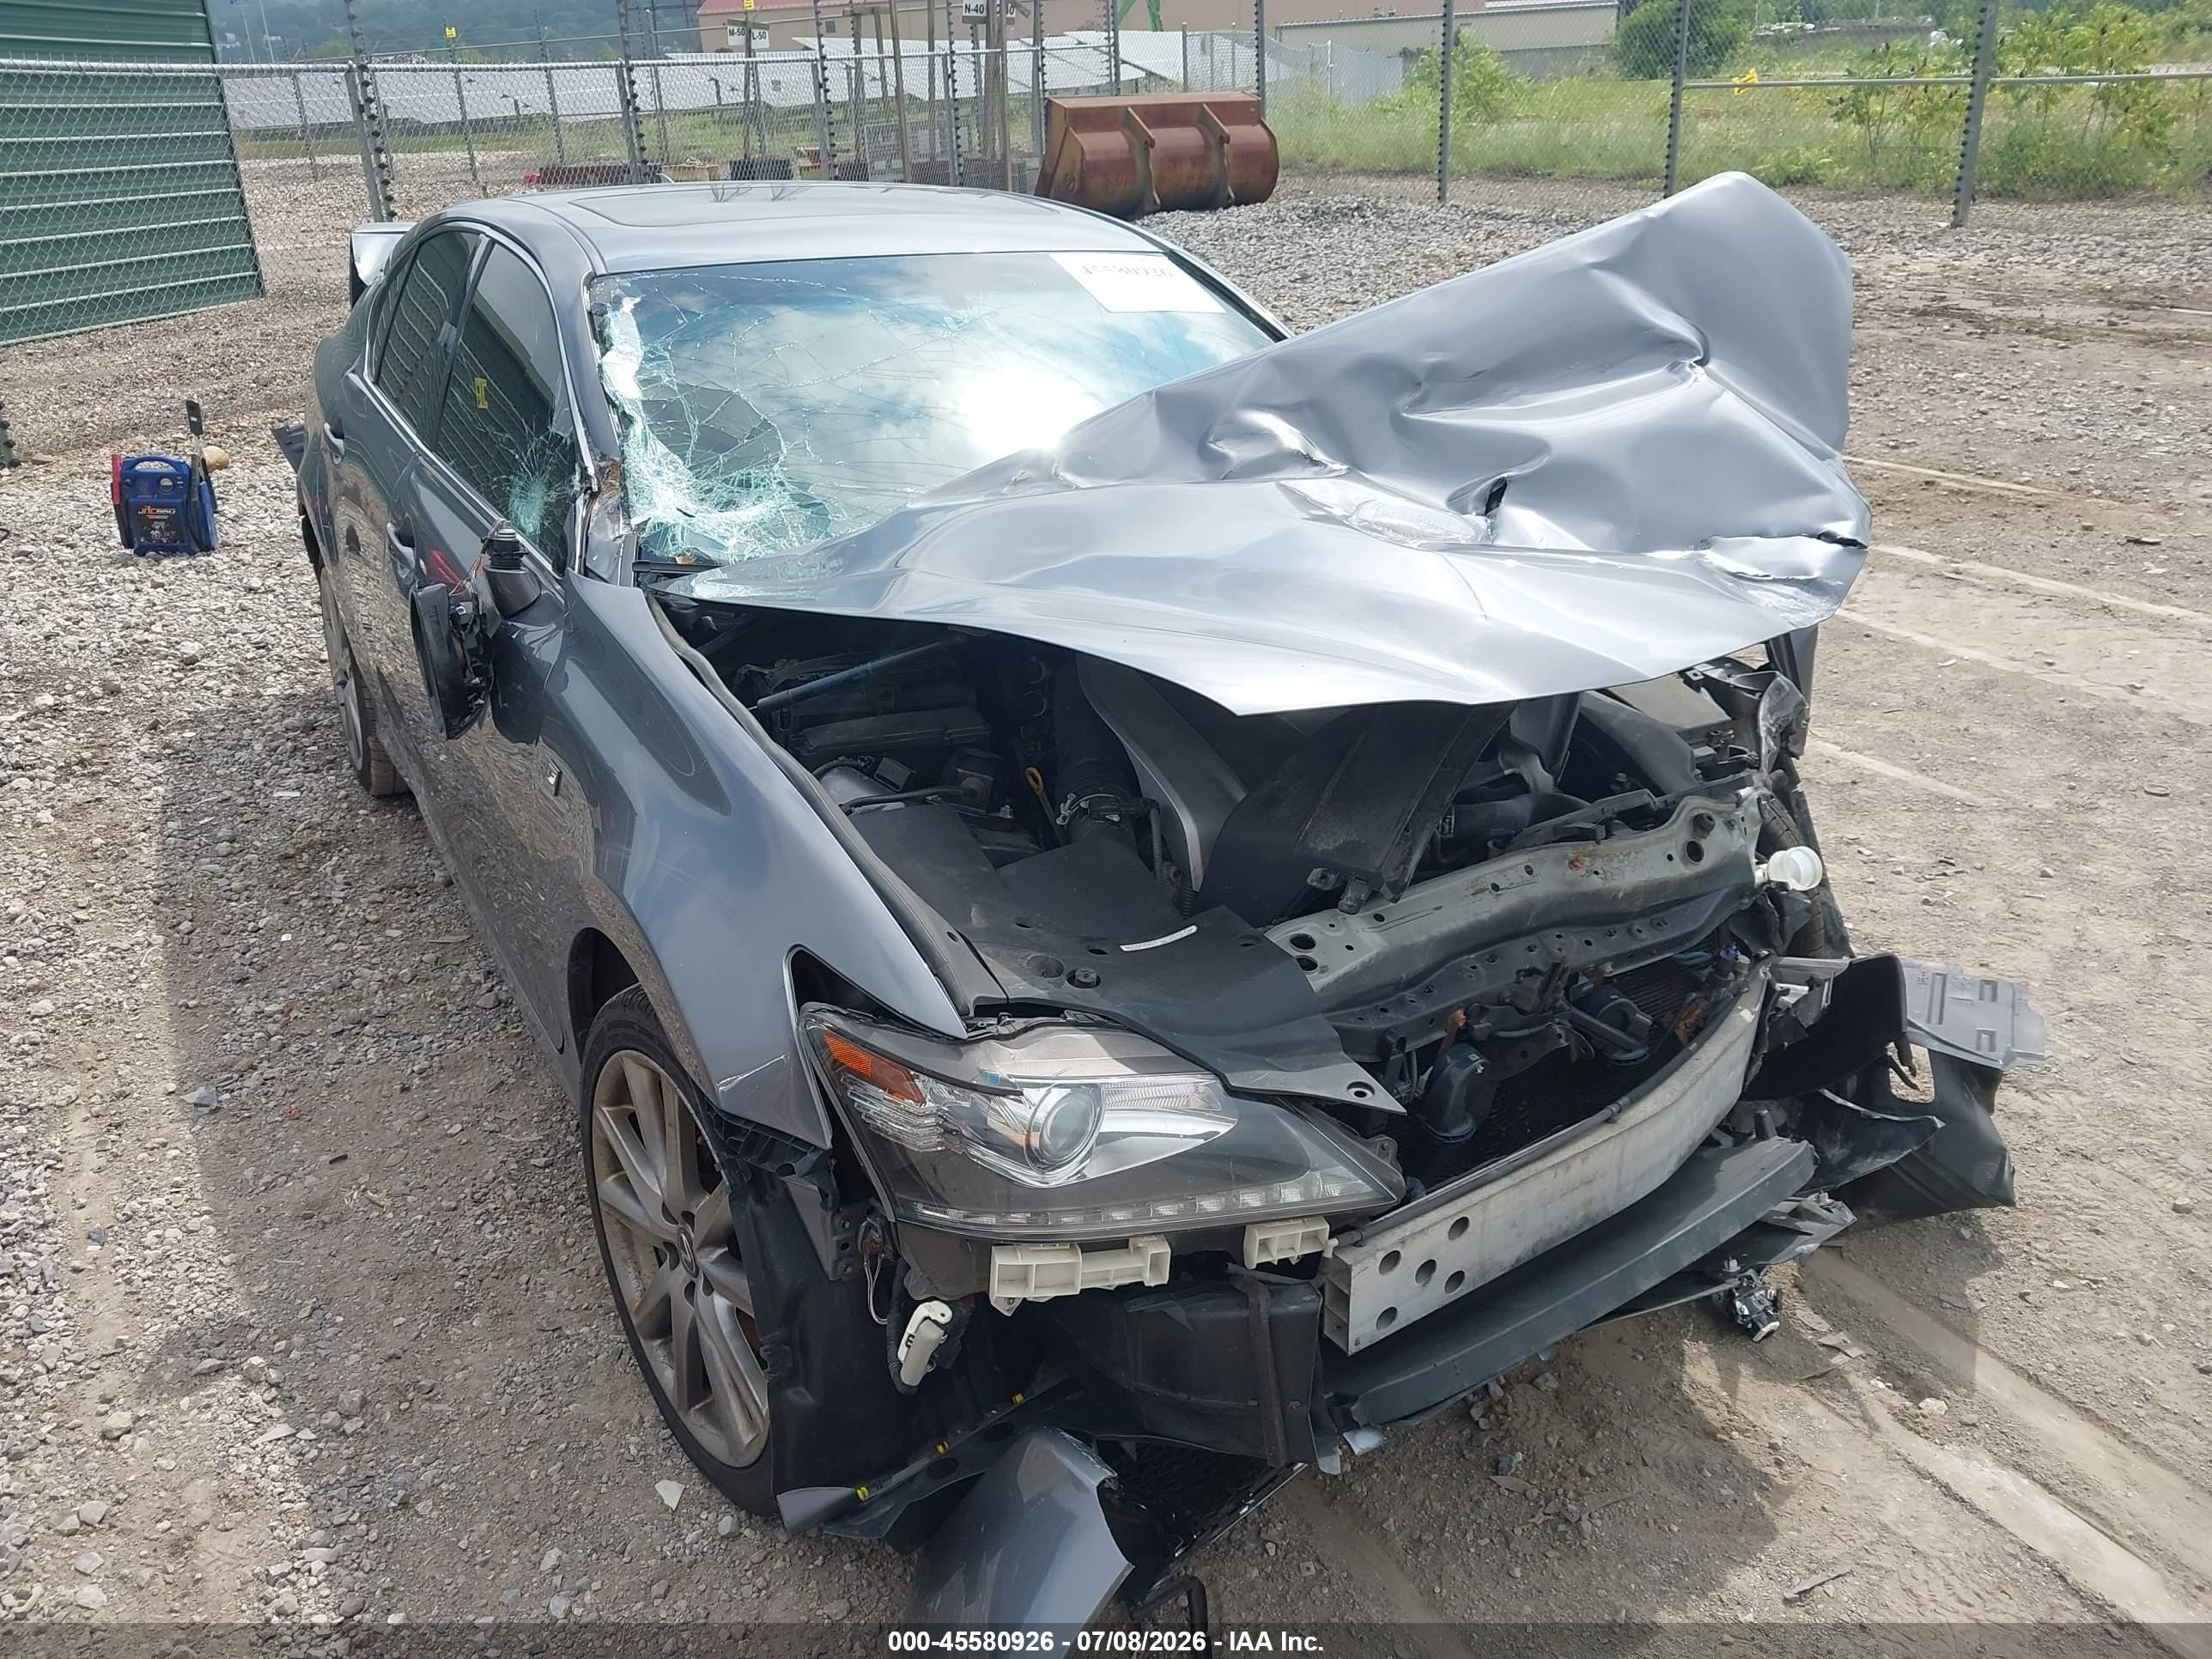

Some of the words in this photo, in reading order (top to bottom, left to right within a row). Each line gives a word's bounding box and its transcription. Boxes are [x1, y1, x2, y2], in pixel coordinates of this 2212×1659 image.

[964, 3, 985, 14] N-40
[728, 27, 745, 36] M-50
[751, 31, 767, 40] L-50
